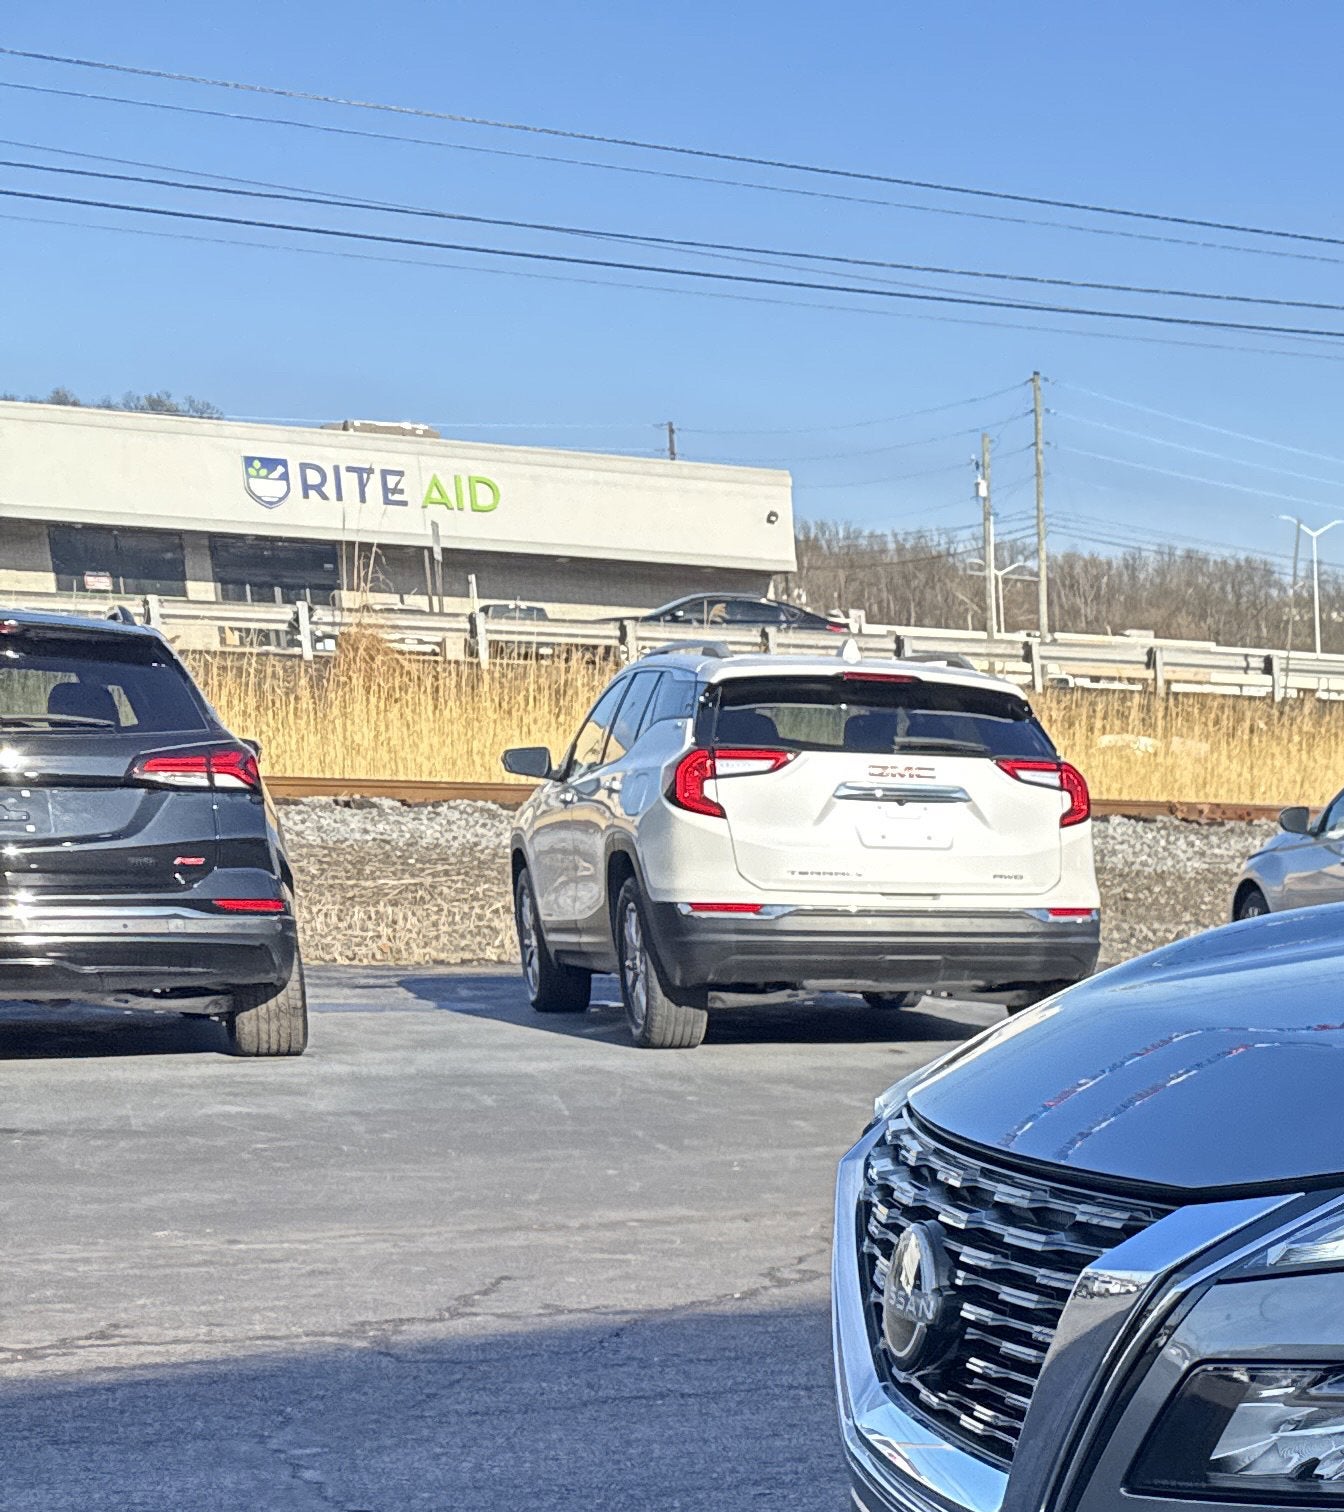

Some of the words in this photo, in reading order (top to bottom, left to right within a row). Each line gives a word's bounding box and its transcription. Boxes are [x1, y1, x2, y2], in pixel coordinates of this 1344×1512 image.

[299, 462, 408, 507] RITE
[421, 473, 501, 512] AID
[889, 1287, 935, 1321] SSAN
